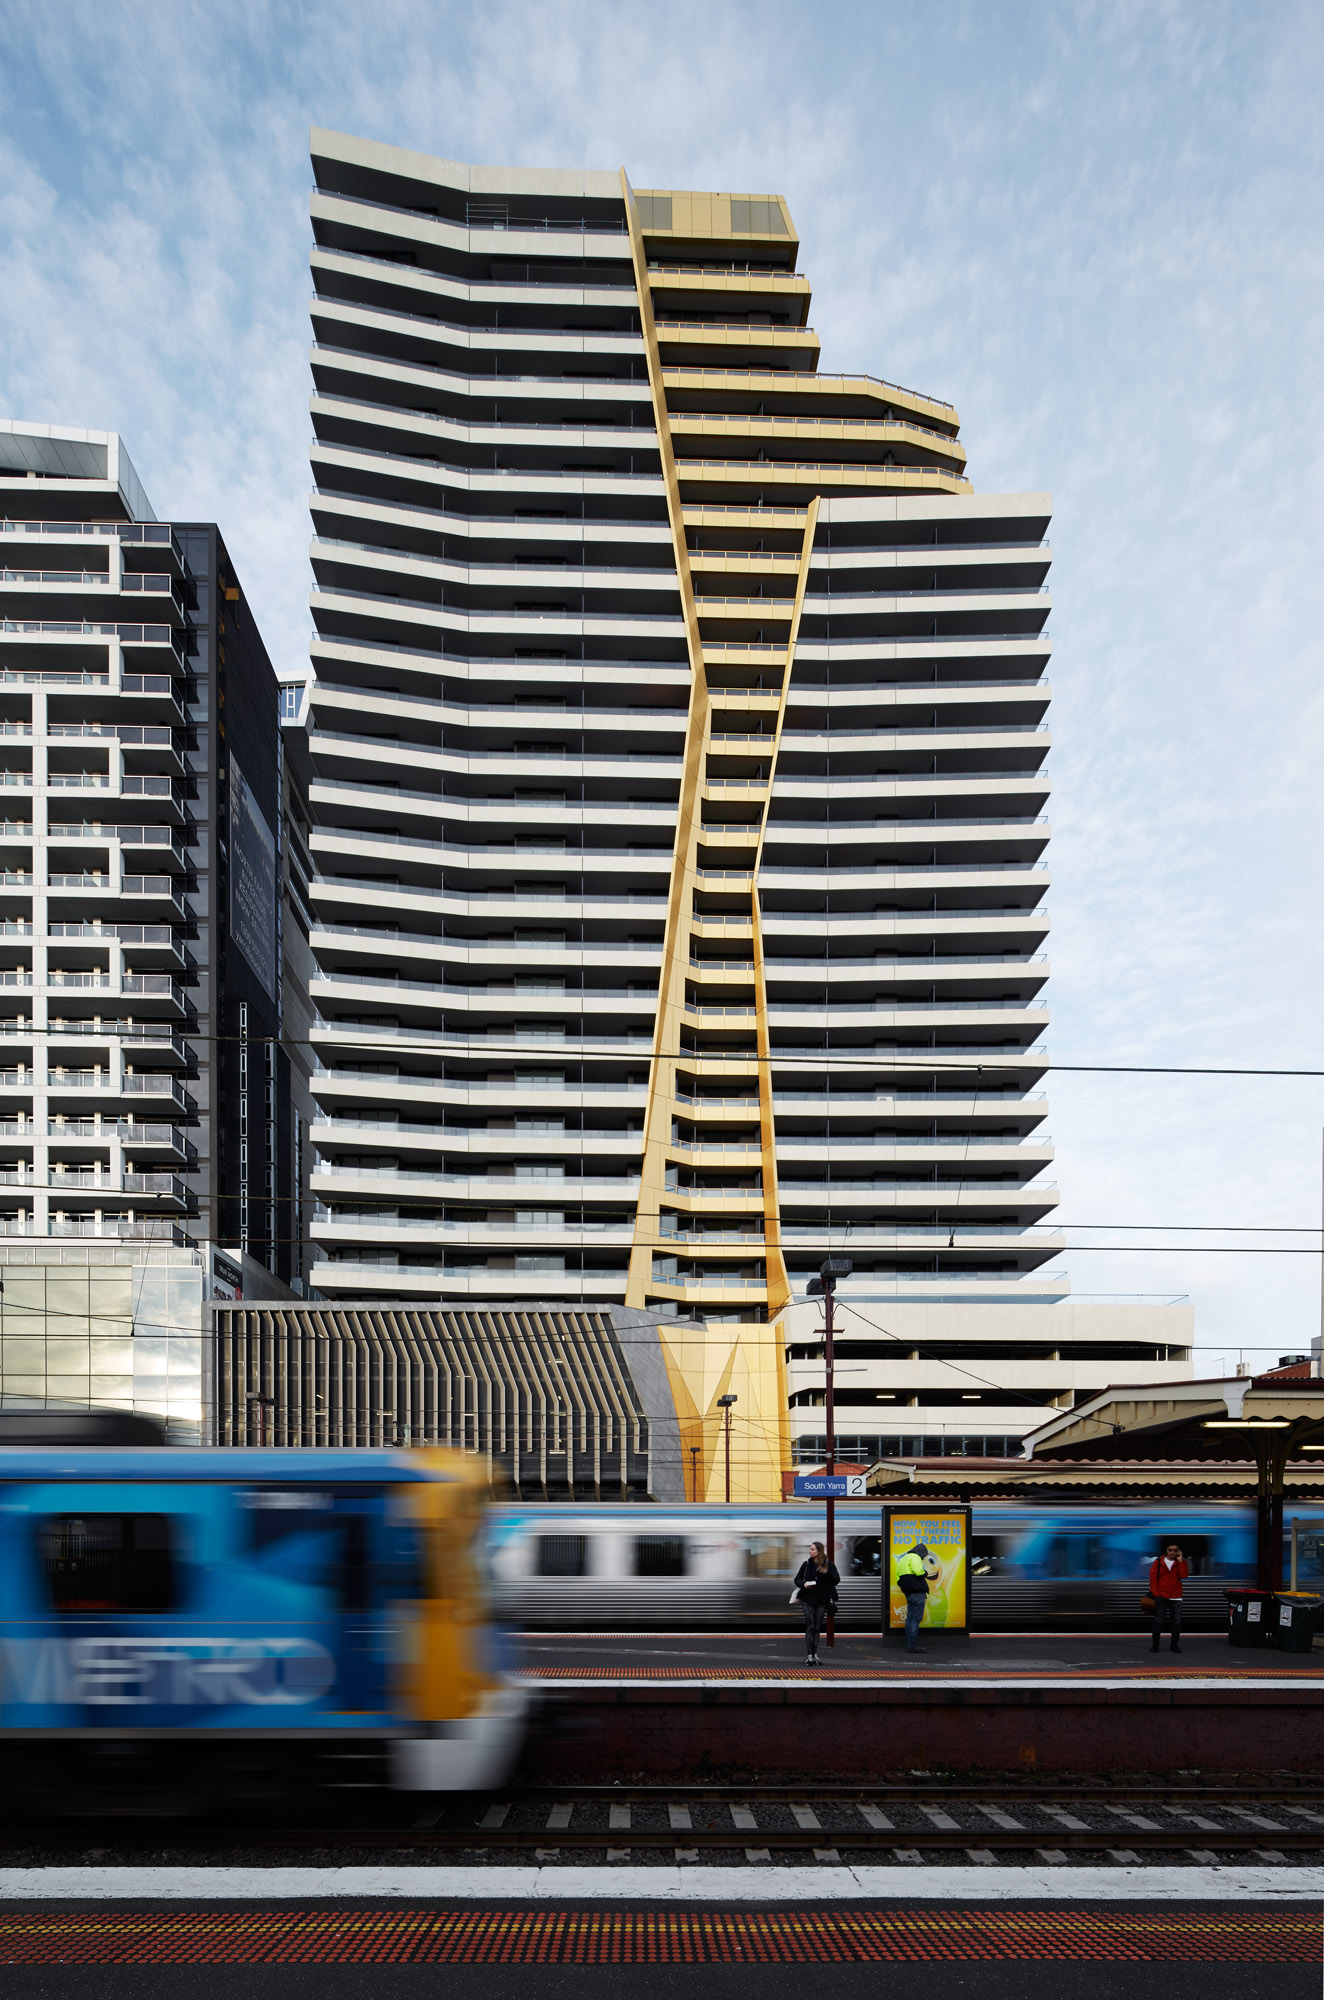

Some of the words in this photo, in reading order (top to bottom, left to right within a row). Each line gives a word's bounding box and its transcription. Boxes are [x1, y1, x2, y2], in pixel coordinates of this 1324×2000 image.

[234, 839, 254, 881] NORTH
[253, 874, 273, 916] FACING
[235, 887, 250, 920] NOW
[804, 1481, 826, 1490] South
[827, 1481, 846, 1490] Yarra
[851, 1477, 863, 1495] 2
[893, 1519, 917, 1528] HOW
[919, 1519, 940, 1528] YOU
[941, 1519, 962, 1528] FEEL
[893, 1527, 922, 1536] WHEN
[923, 1527, 951, 1536] THERE
[953, 1527, 962, 1536] IS
[893, 1535, 913, 1545] NO
[915, 1535, 962, 1545] TRAFFIC
[0, 1637, 337, 1705] METRO
